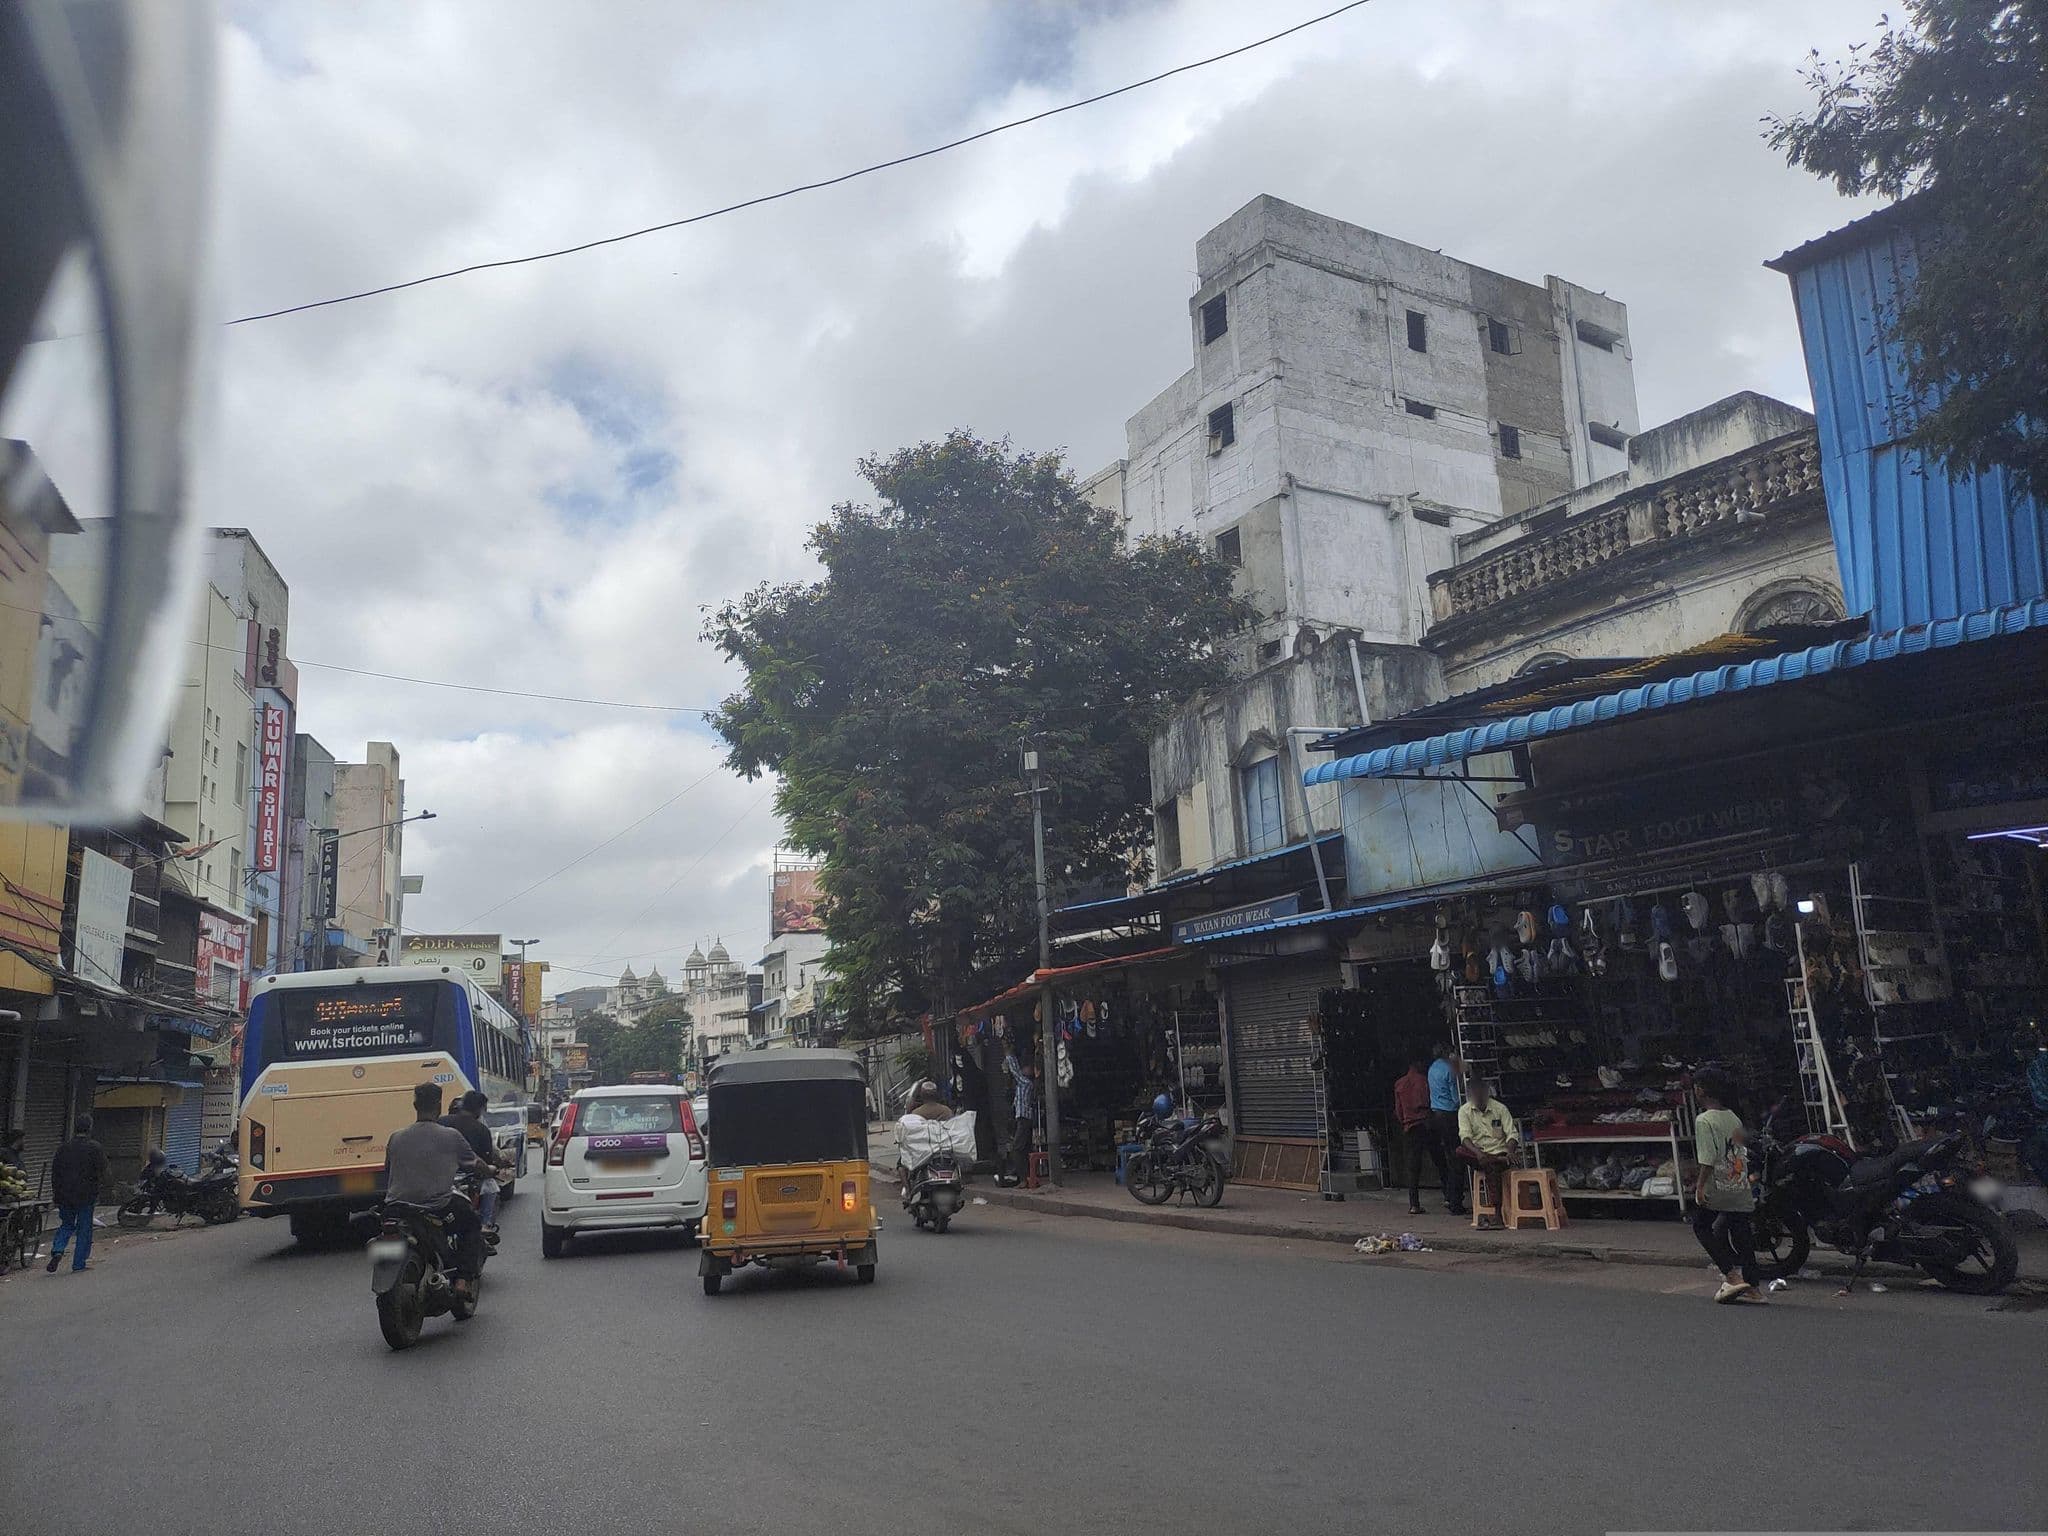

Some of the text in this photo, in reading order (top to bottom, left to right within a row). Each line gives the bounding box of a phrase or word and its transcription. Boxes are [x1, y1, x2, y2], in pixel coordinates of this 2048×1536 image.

[262, 710, 281, 867] KUMAR SHIRTS
[1553, 799, 1786, 856] STAR FOOT WEAR
[323, 844, 333, 873] CAP
[1221, 913, 1243, 928] FOOT
[1245, 907, 1271, 923] WEAR
[377, 936, 390, 966] NA
[310, 1022, 405, 1036] Book your tickets online
[434, 1073, 454, 1083] SRD
[594, 1137, 621, 1148] odoo
